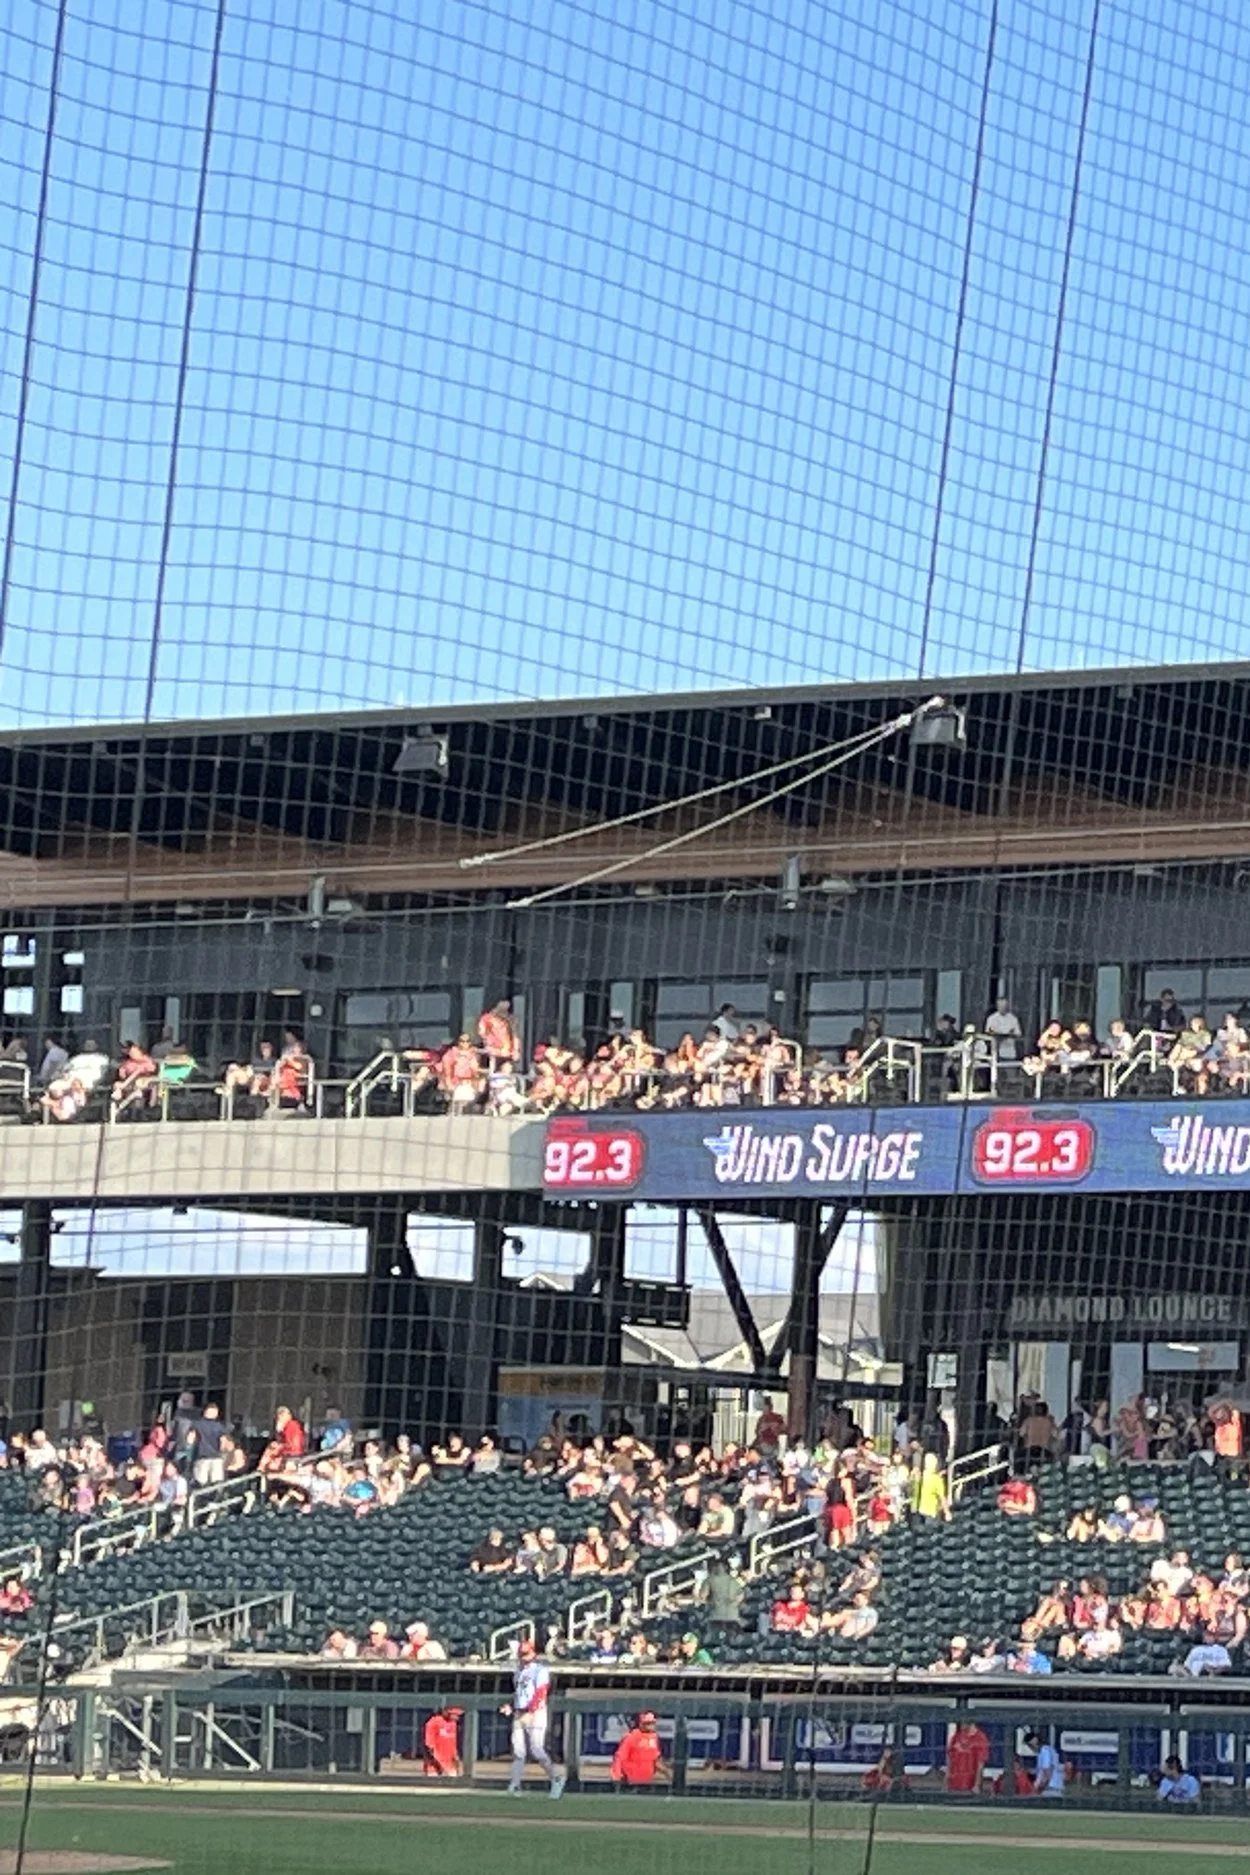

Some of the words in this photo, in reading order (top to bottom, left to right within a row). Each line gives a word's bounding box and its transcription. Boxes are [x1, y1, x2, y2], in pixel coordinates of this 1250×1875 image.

[543, 1139, 632, 1182] 92.3
[710, 1124, 804, 1183] WIND
[805, 1123, 923, 1182] SURGE
[983, 1129, 1079, 1174] 92.3
[1011, 1295, 1125, 1323] DIAMOND
[1133, 1293, 1233, 1322] LOUNGE
